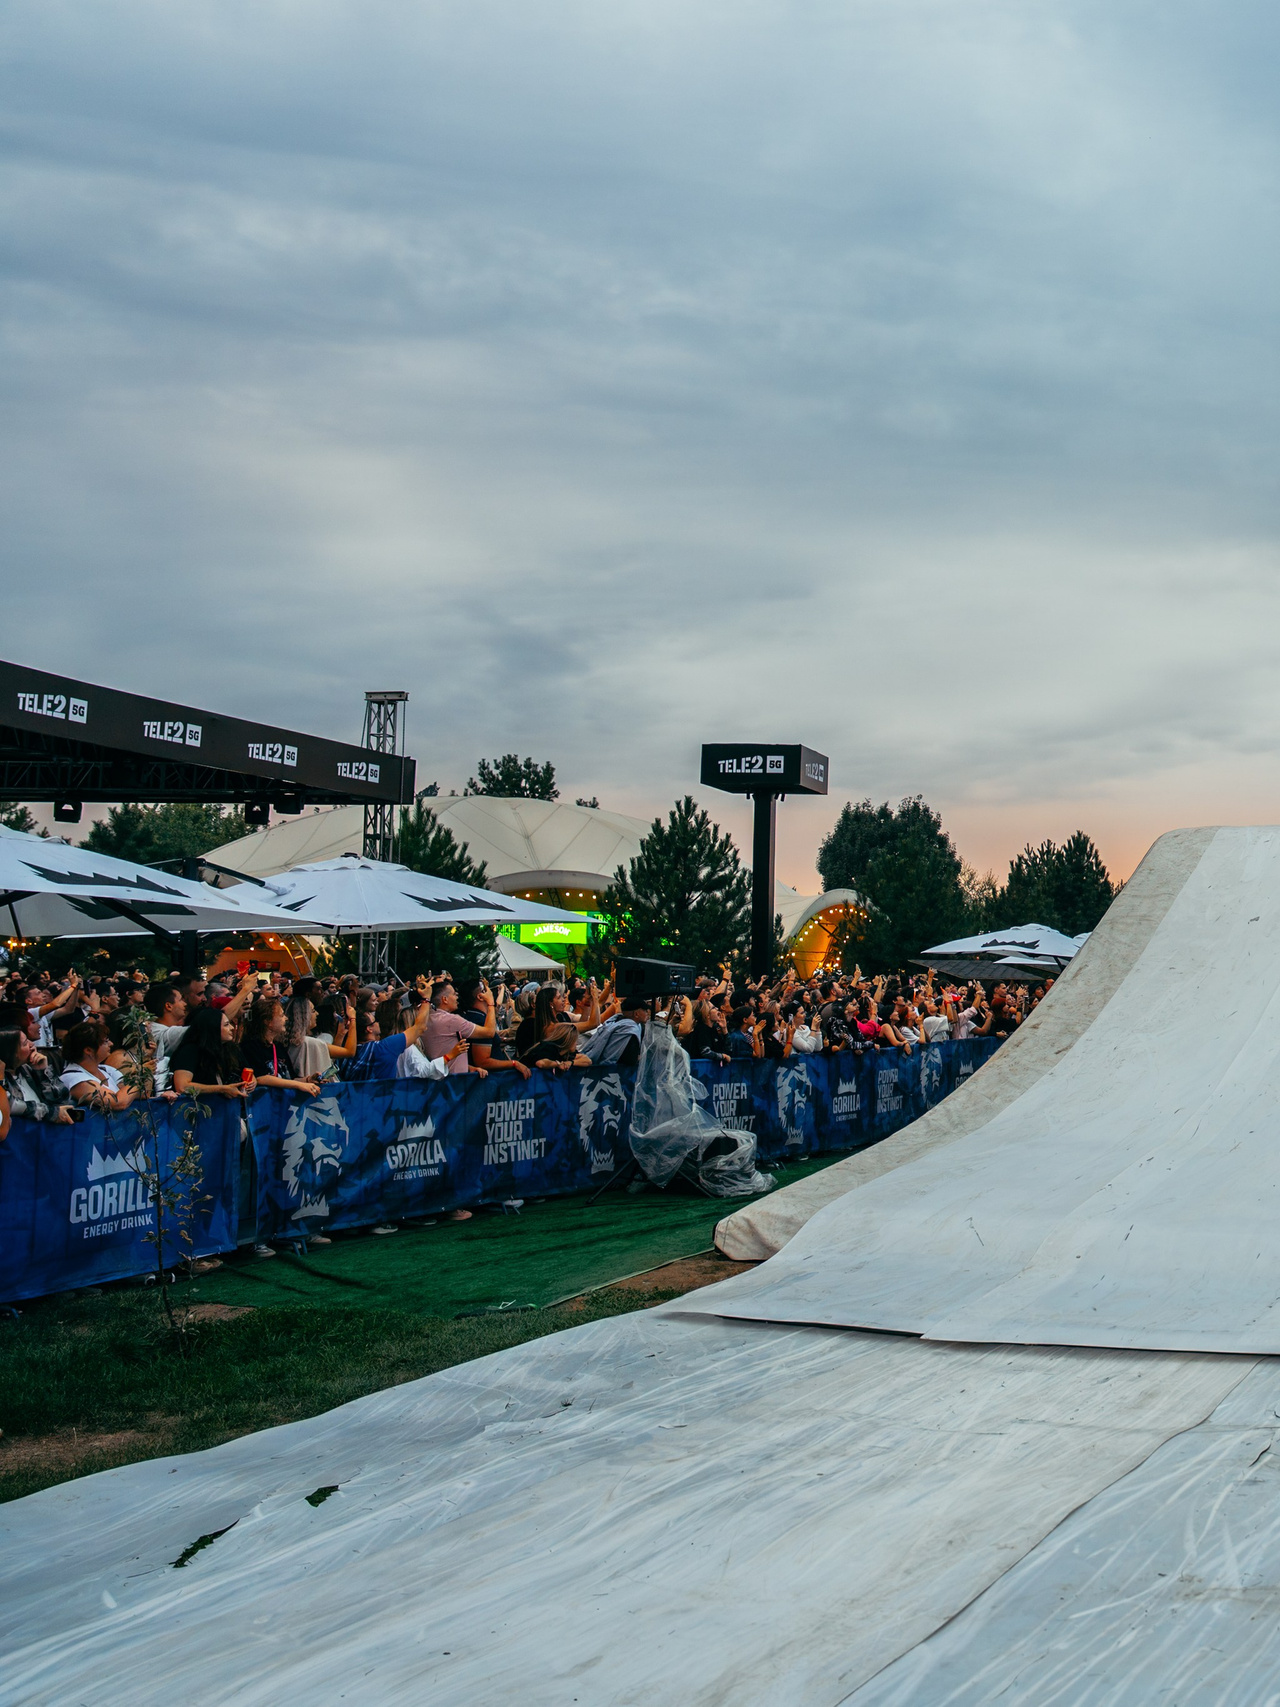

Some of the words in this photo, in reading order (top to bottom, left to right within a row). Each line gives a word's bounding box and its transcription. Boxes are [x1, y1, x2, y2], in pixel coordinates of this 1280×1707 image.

[17, 692, 67, 720] TELE2
[143, 721, 184, 744] TELE2
[247, 743, 283, 764] TELE2
[718, 755, 764, 773] TELE2
[337, 761, 367, 781] TELE2
[533, 925, 571, 937] JAMESON
[713, 1082, 748, 1101] POWER
[485, 1098, 535, 1124] POWER
[713, 1100, 737, 1118] YOUR
[832, 1094, 861, 1114] GORILLA
[485, 1120, 523, 1144] YOUR
[386, 1139, 447, 1170] GORILLA
[483, 1137, 547, 1166] INSTINCT
[393, 1169, 417, 1181] ENERGY
[417, 1167, 440, 1178] DRINK
[83, 1219, 120, 1239] ENERGY
[121, 1213, 154, 1231] DRINK
